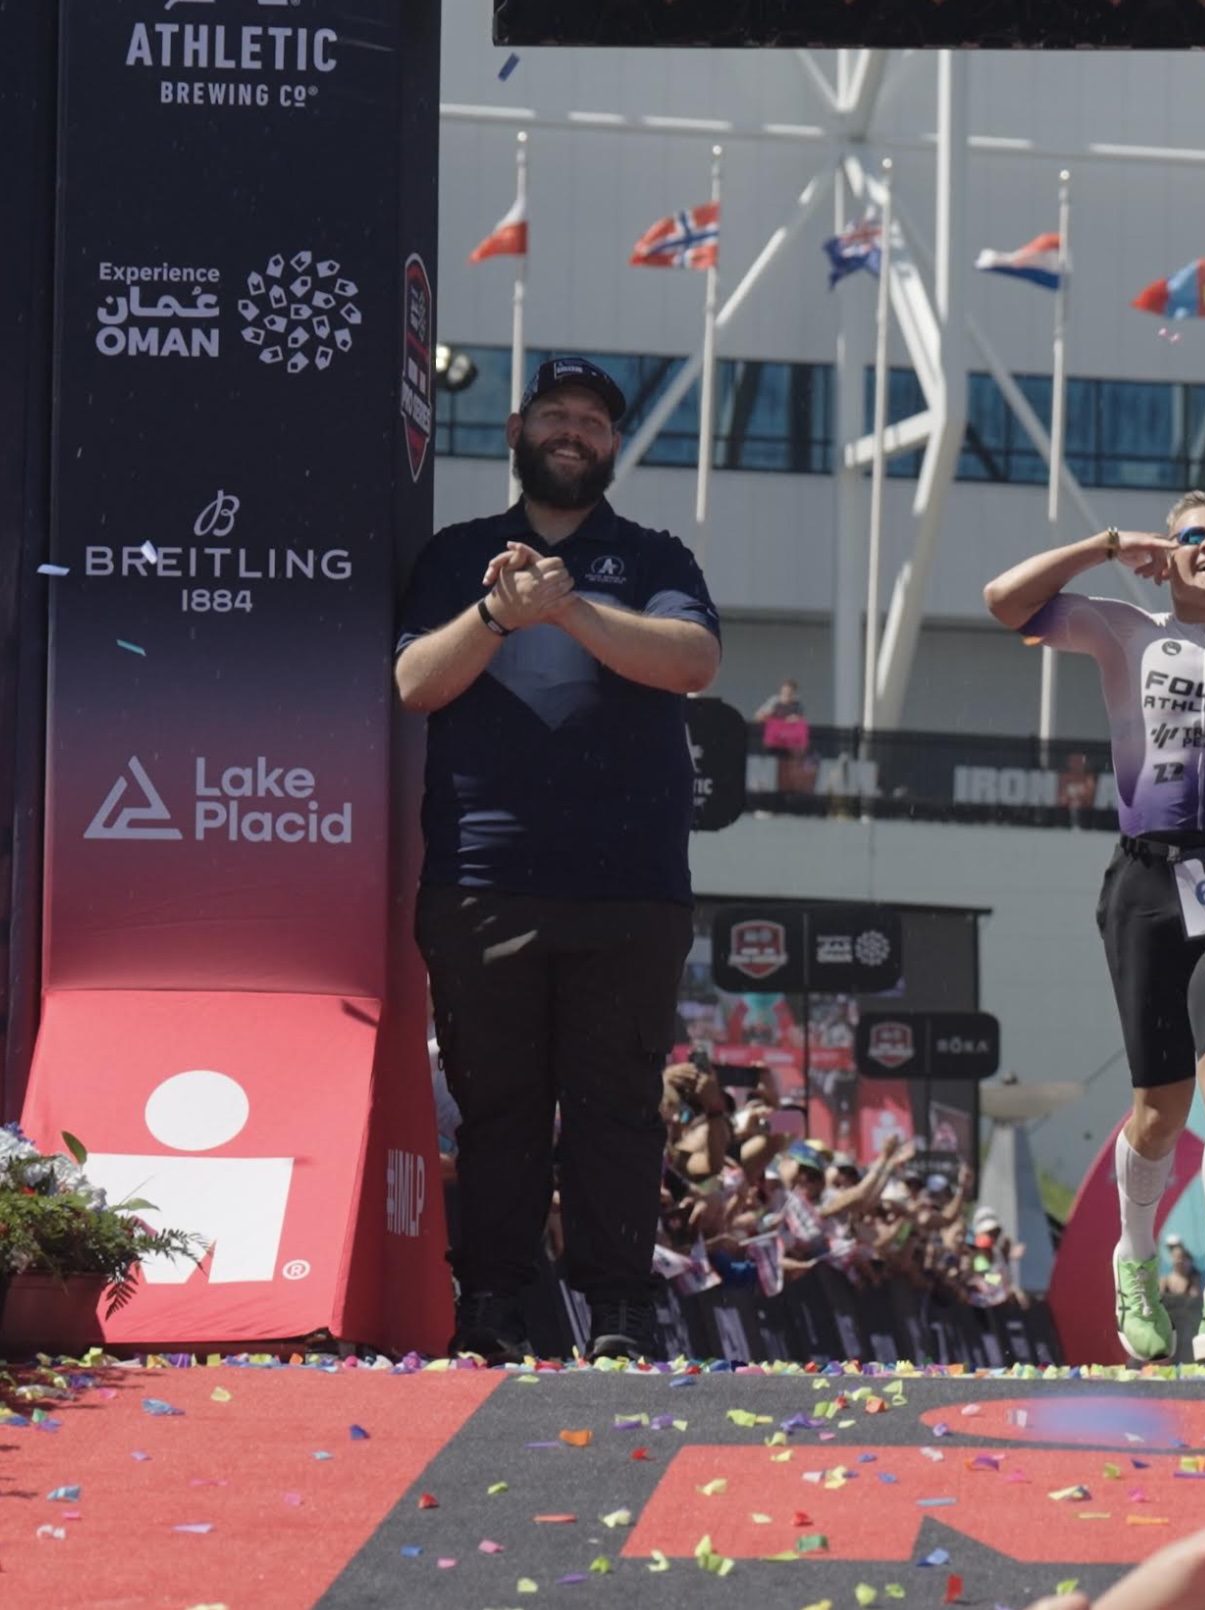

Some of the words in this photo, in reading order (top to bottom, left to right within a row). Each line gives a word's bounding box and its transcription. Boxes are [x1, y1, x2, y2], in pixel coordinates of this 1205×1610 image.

[126, 22, 338, 73] ATHLETIC
[161, 81, 270, 107] BREWING
[100, 262, 221, 285] Experience
[96, 327, 220, 358] OMAN
[85, 545, 353, 581] BREITLING
[181, 589, 253, 613] 1884
[195, 757, 315, 798] Lake
[195, 801, 352, 844] Placid
